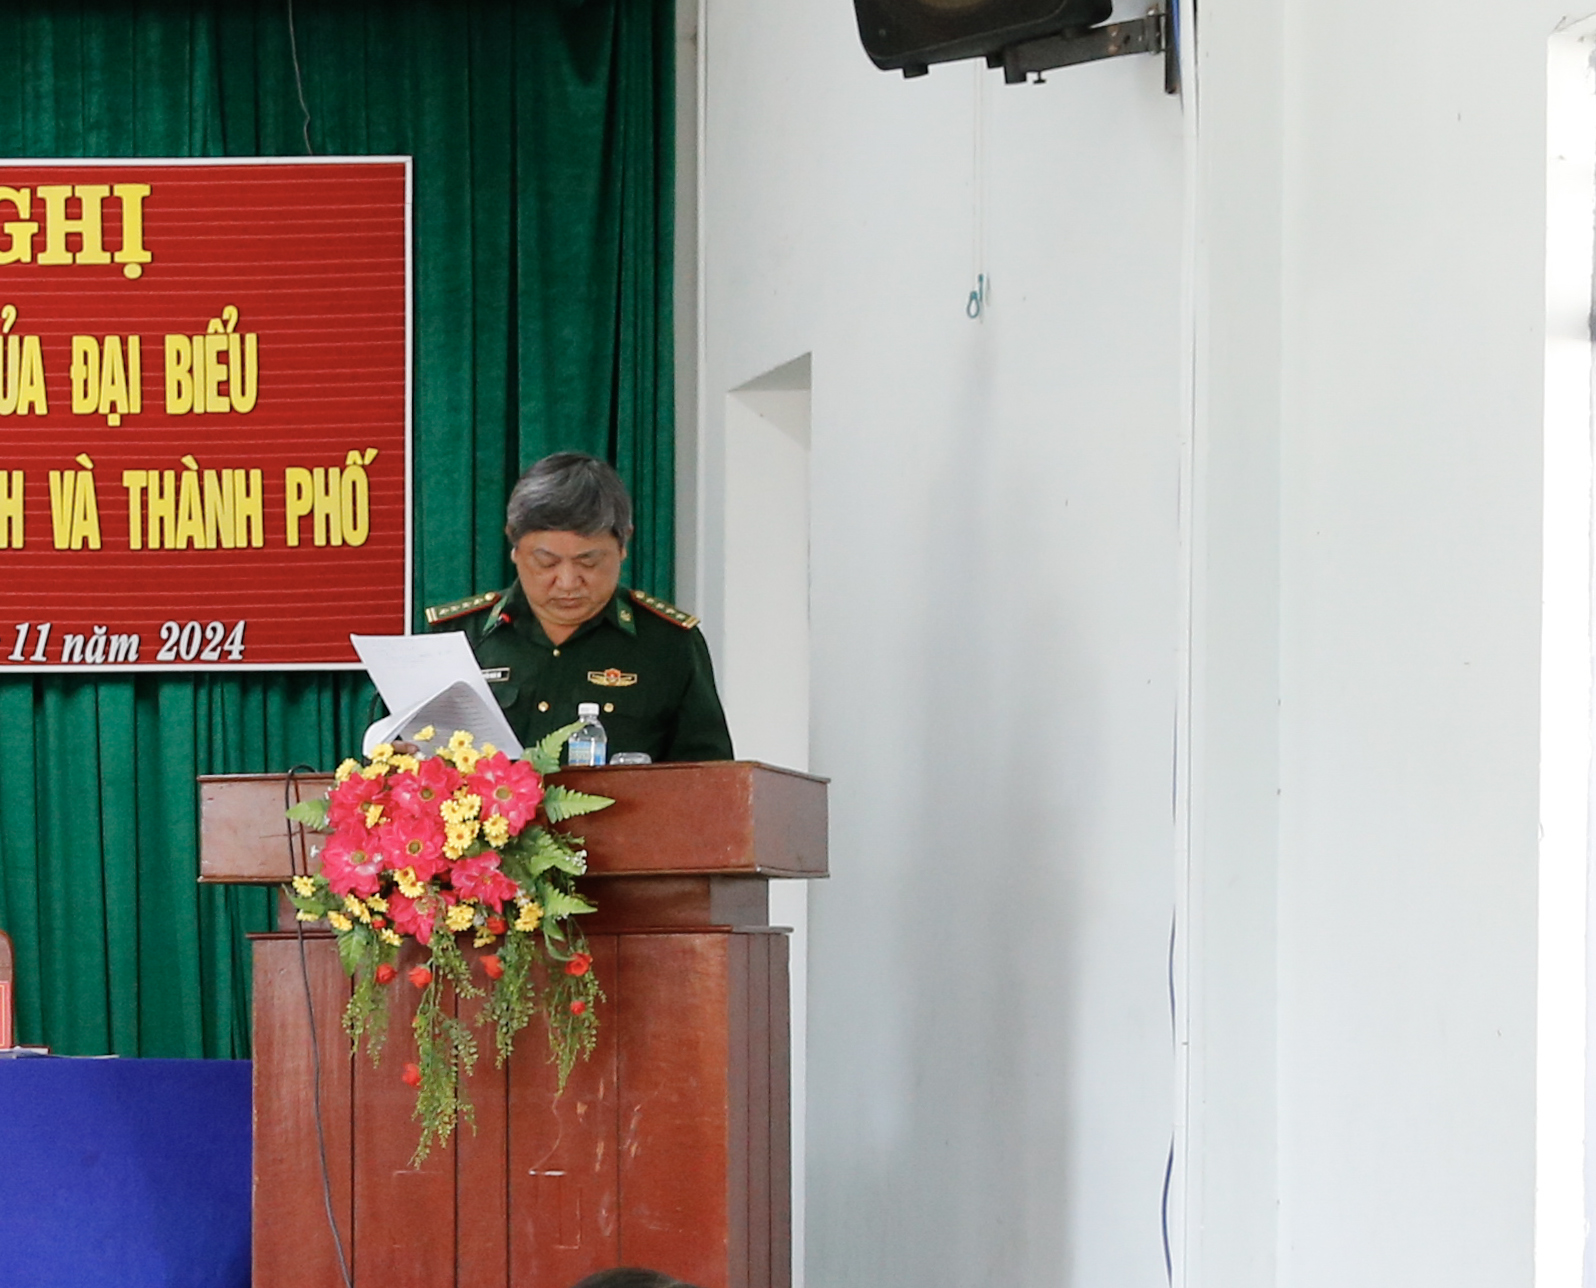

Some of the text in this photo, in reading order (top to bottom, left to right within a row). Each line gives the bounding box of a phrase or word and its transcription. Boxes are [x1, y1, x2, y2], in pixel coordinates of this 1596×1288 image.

[70, 335, 141, 427] ĐẠI
[164, 305, 258, 414] BIỂU
[49, 453, 102, 550] VÀ
[122, 454, 264, 550] THÀNH
[285, 448, 379, 548] PHỐ
[8, 621, 48, 663] 11
[60, 624, 140, 663] năm
[158, 620, 247, 662] 2024
